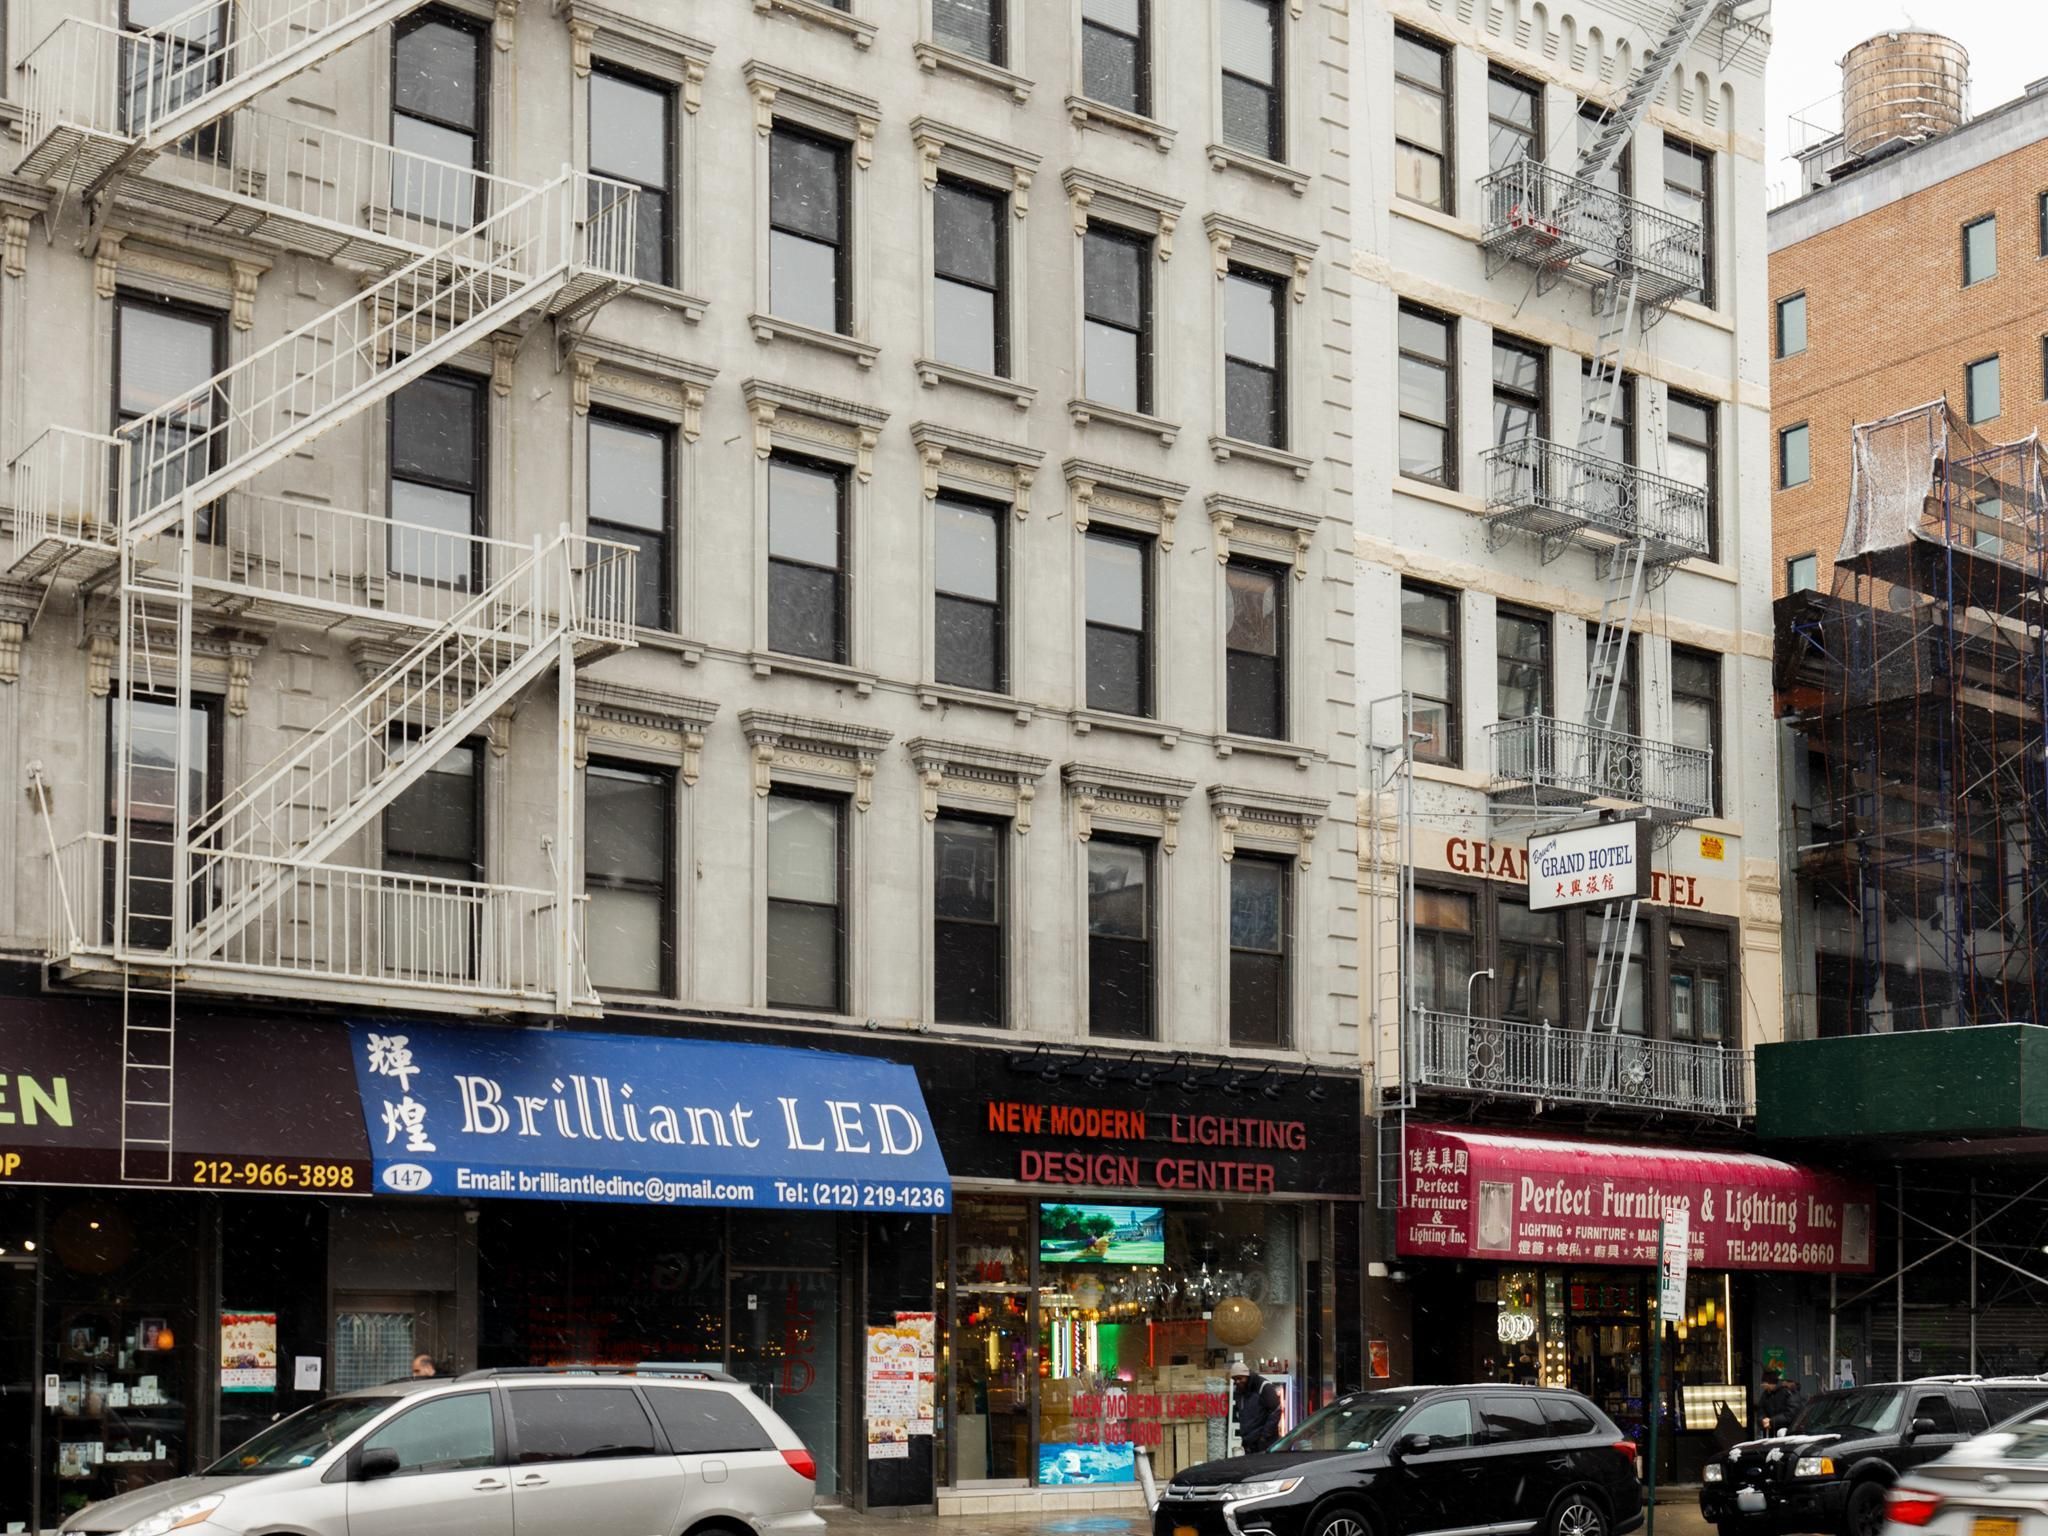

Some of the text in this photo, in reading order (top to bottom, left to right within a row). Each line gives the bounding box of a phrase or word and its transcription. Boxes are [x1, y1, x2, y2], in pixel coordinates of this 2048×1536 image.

[1541, 845, 1632, 878] GRAND HOTEL
[1650, 872, 1704, 907] TEL
[453, 1074, 923, 1156] Brilliant LED
[988, 1101, 1306, 1150] NEW MODERN LIGHTING
[193, 1160, 354, 1188] 212-966-3898
[390, 1170, 423, 1185] 147
[1021, 1150, 1275, 1194] DESIGN CENTER
[1416, 1178, 1459, 1193] Perfect
[457, 1168, 945, 1208] Email: brilliantledinc@gmail.com Tel: (212) 219-1236
[1411, 1194, 1468, 1210] Furniture
[1432, 1210, 1443, 1225] &
[1520, 1176, 1591, 1216] Perfect
[1602, 1182, 1690, 1220] Furniture
[1701, 1188, 1715, 1222] &
[1725, 1189, 1797, 1234] Lighting
[1807, 1195, 1836, 1228] Inc.
[1409, 1227, 1467, 1246] Lighting Inc.
[1519, 1223, 1562, 1238] LIGHTING
[1575, 1226, 1626, 1241] FURNITURE
[1072, 1392, 1229, 1418] NEW MODERN LIGHTING
